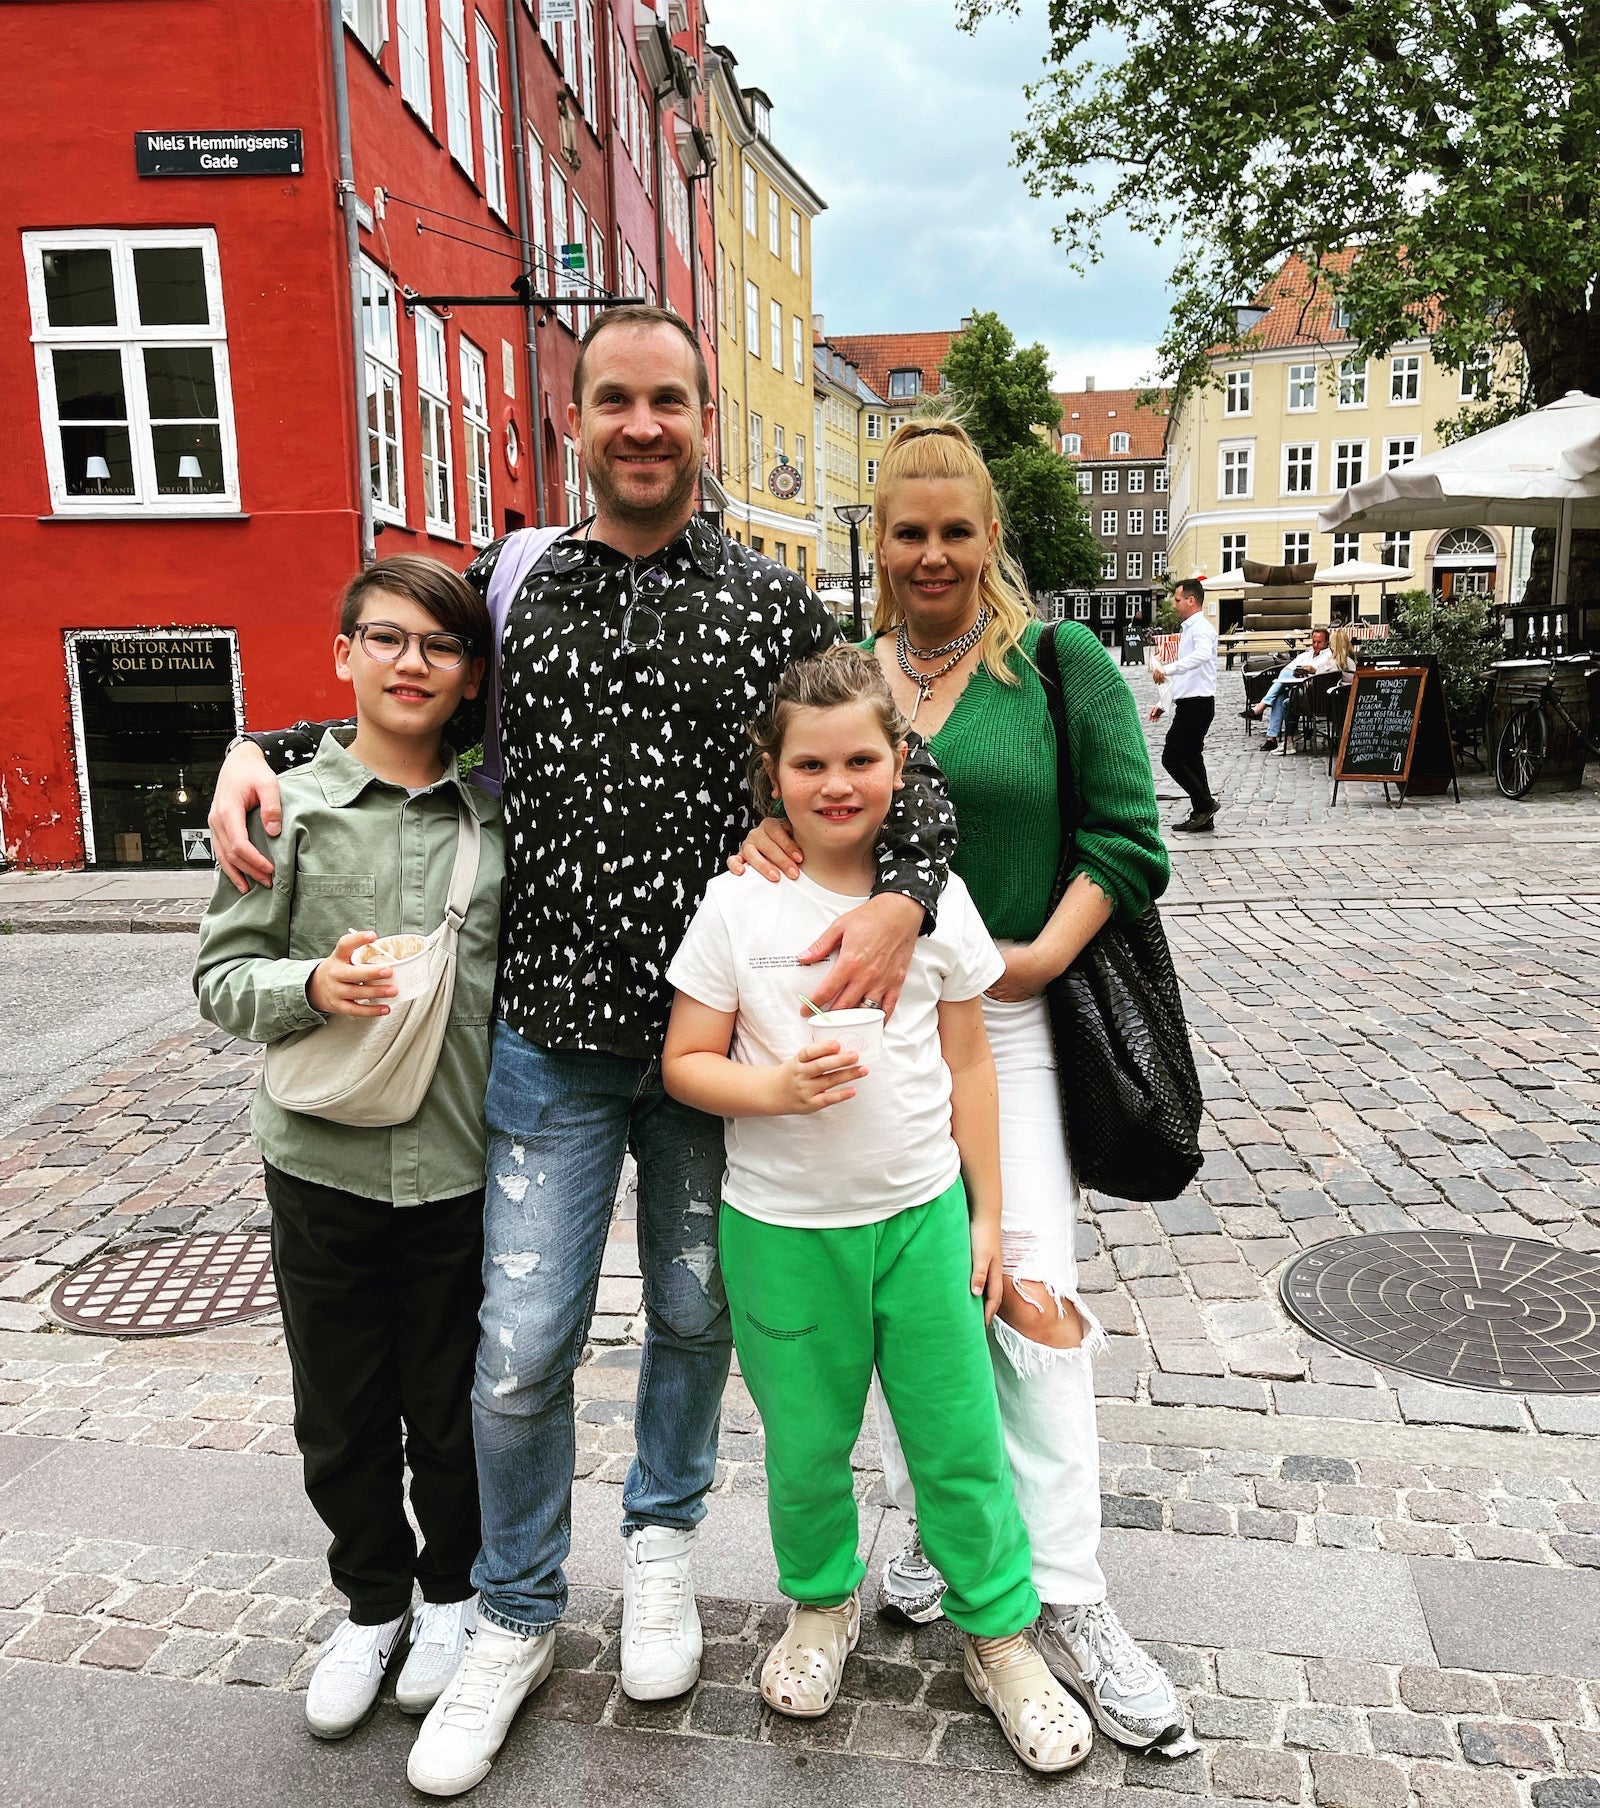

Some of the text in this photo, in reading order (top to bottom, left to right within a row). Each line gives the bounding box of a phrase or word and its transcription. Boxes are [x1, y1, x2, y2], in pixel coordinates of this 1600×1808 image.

[147, 135, 289, 152] Niels Hemmingsens
[200, 154, 239, 169] Gade
[818, 579, 871, 589] PEDER XE
[111, 640, 214, 654] RISTORANTE
[112, 657, 147, 670] SOLE
[168, 657, 215, 670] ITALIA
[1358, 694, 1378, 703] PIZZA
